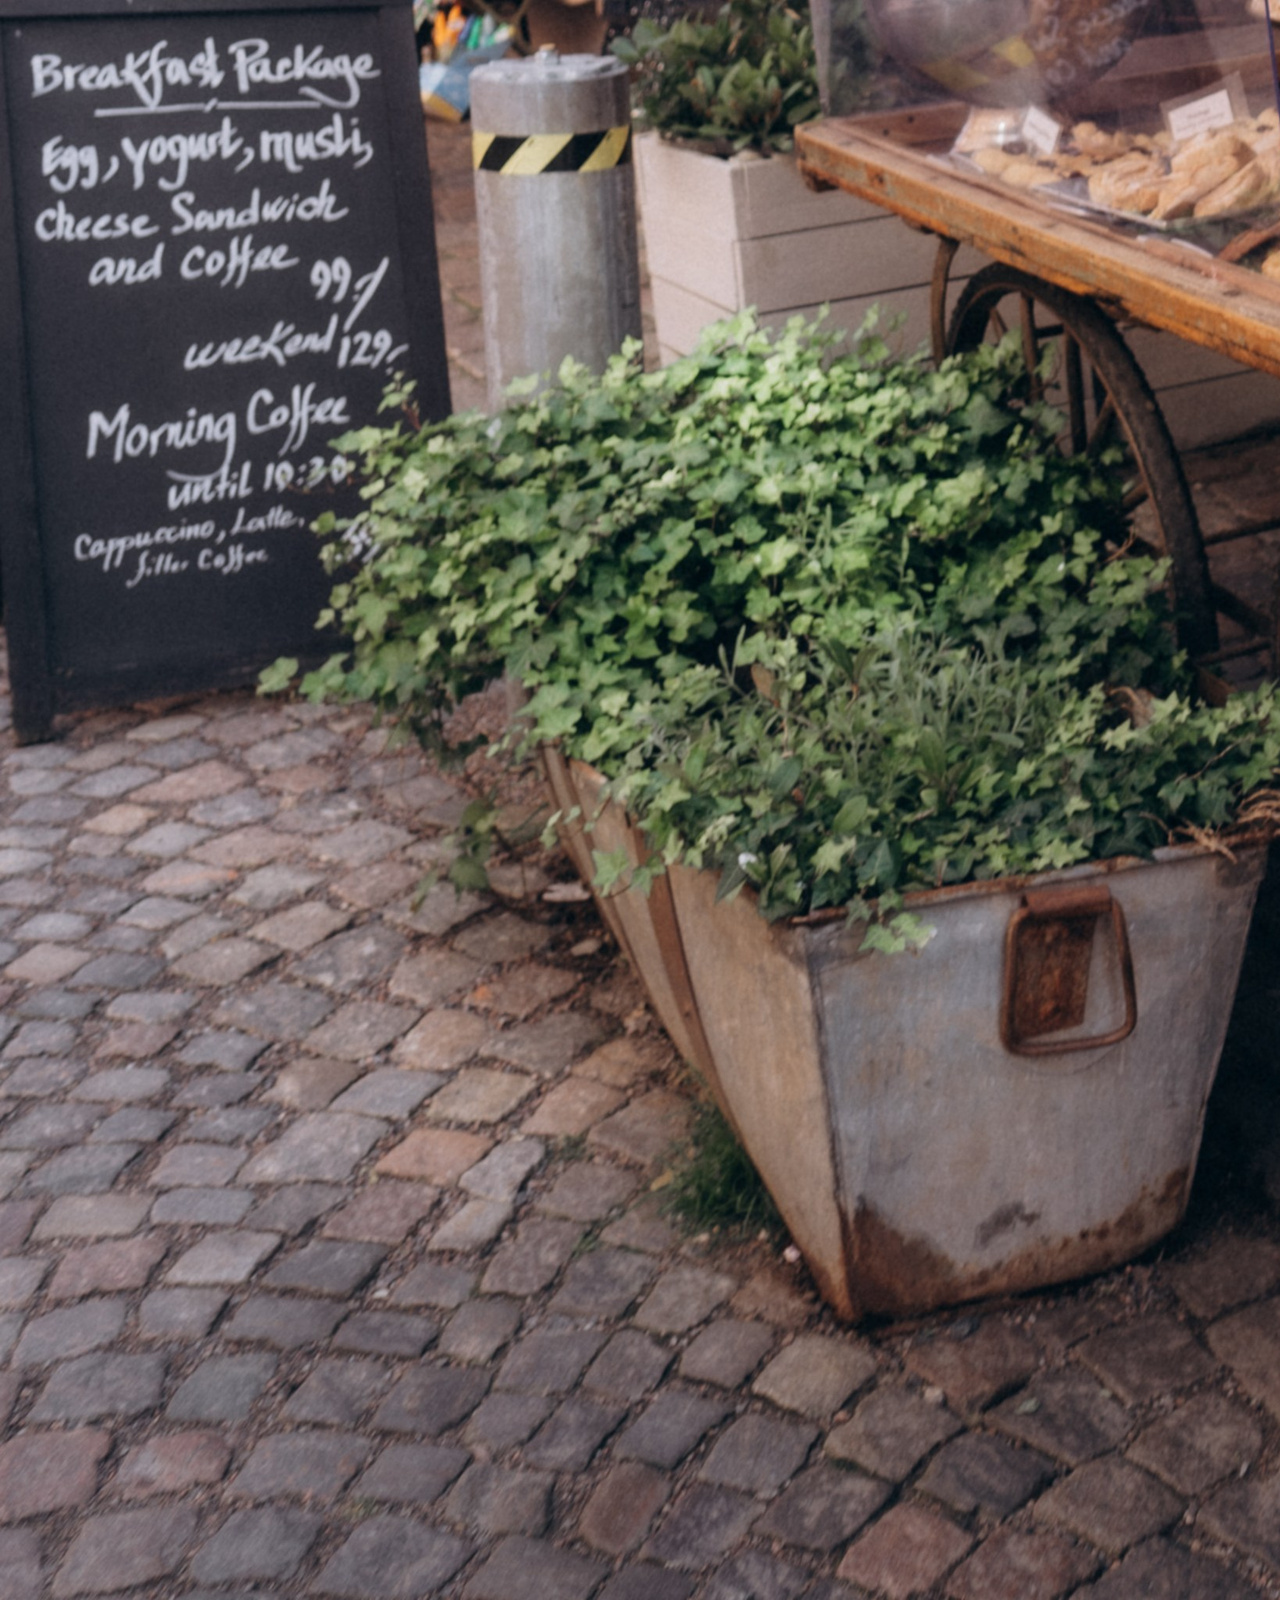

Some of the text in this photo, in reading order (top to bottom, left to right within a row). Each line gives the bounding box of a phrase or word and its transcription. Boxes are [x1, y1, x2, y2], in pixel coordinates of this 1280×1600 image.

[31, 36, 381, 109] Breakfast Package
[170, 178, 349, 235] Sandwich
[88, 242, 165, 287] and
[86, 382, 351, 481] Morning Coffee
[167, 460, 254, 511] until
